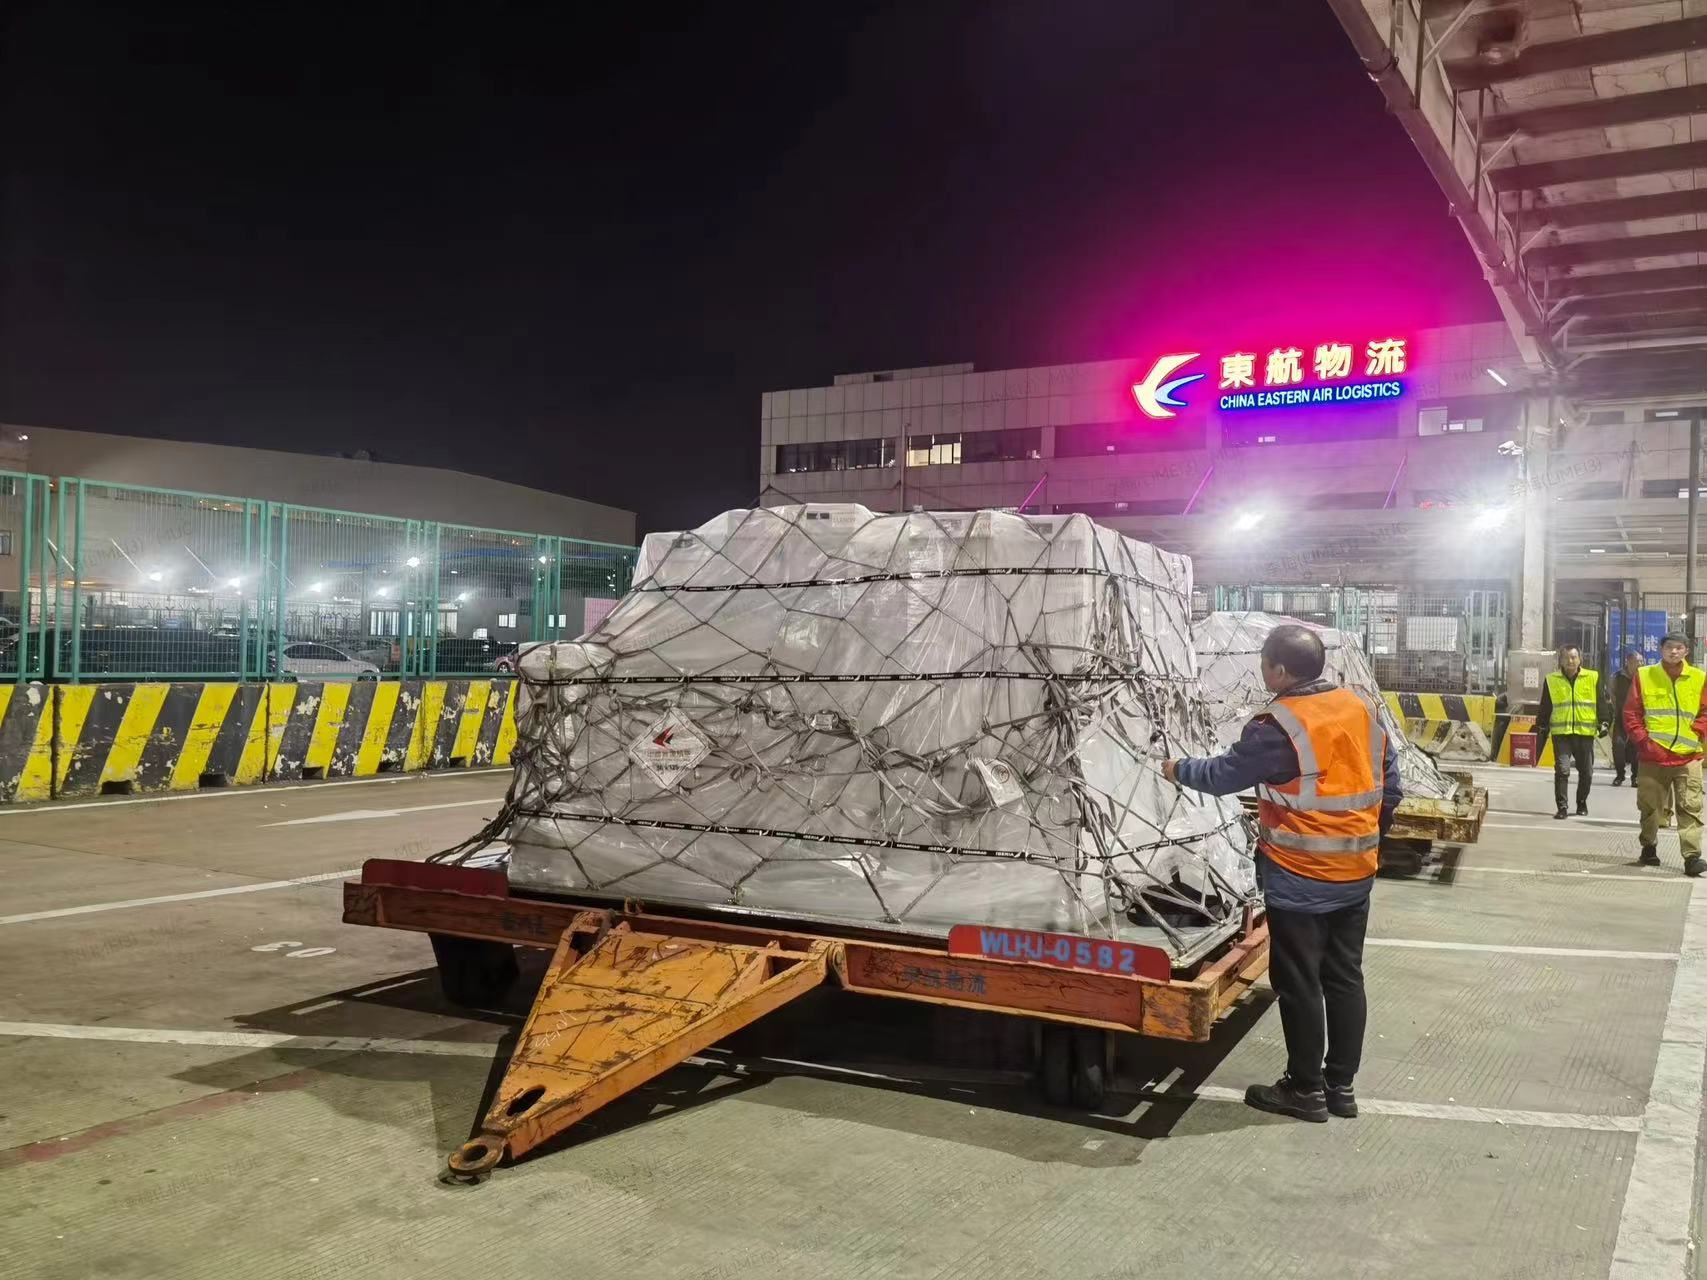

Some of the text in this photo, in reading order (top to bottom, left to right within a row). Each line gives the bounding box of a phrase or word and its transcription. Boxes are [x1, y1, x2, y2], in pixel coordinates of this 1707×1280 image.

[1219, 338, 1406, 389] 東航物流
[1220, 381, 1401, 409] CHINA EASTERN AIR LOGISTICS
